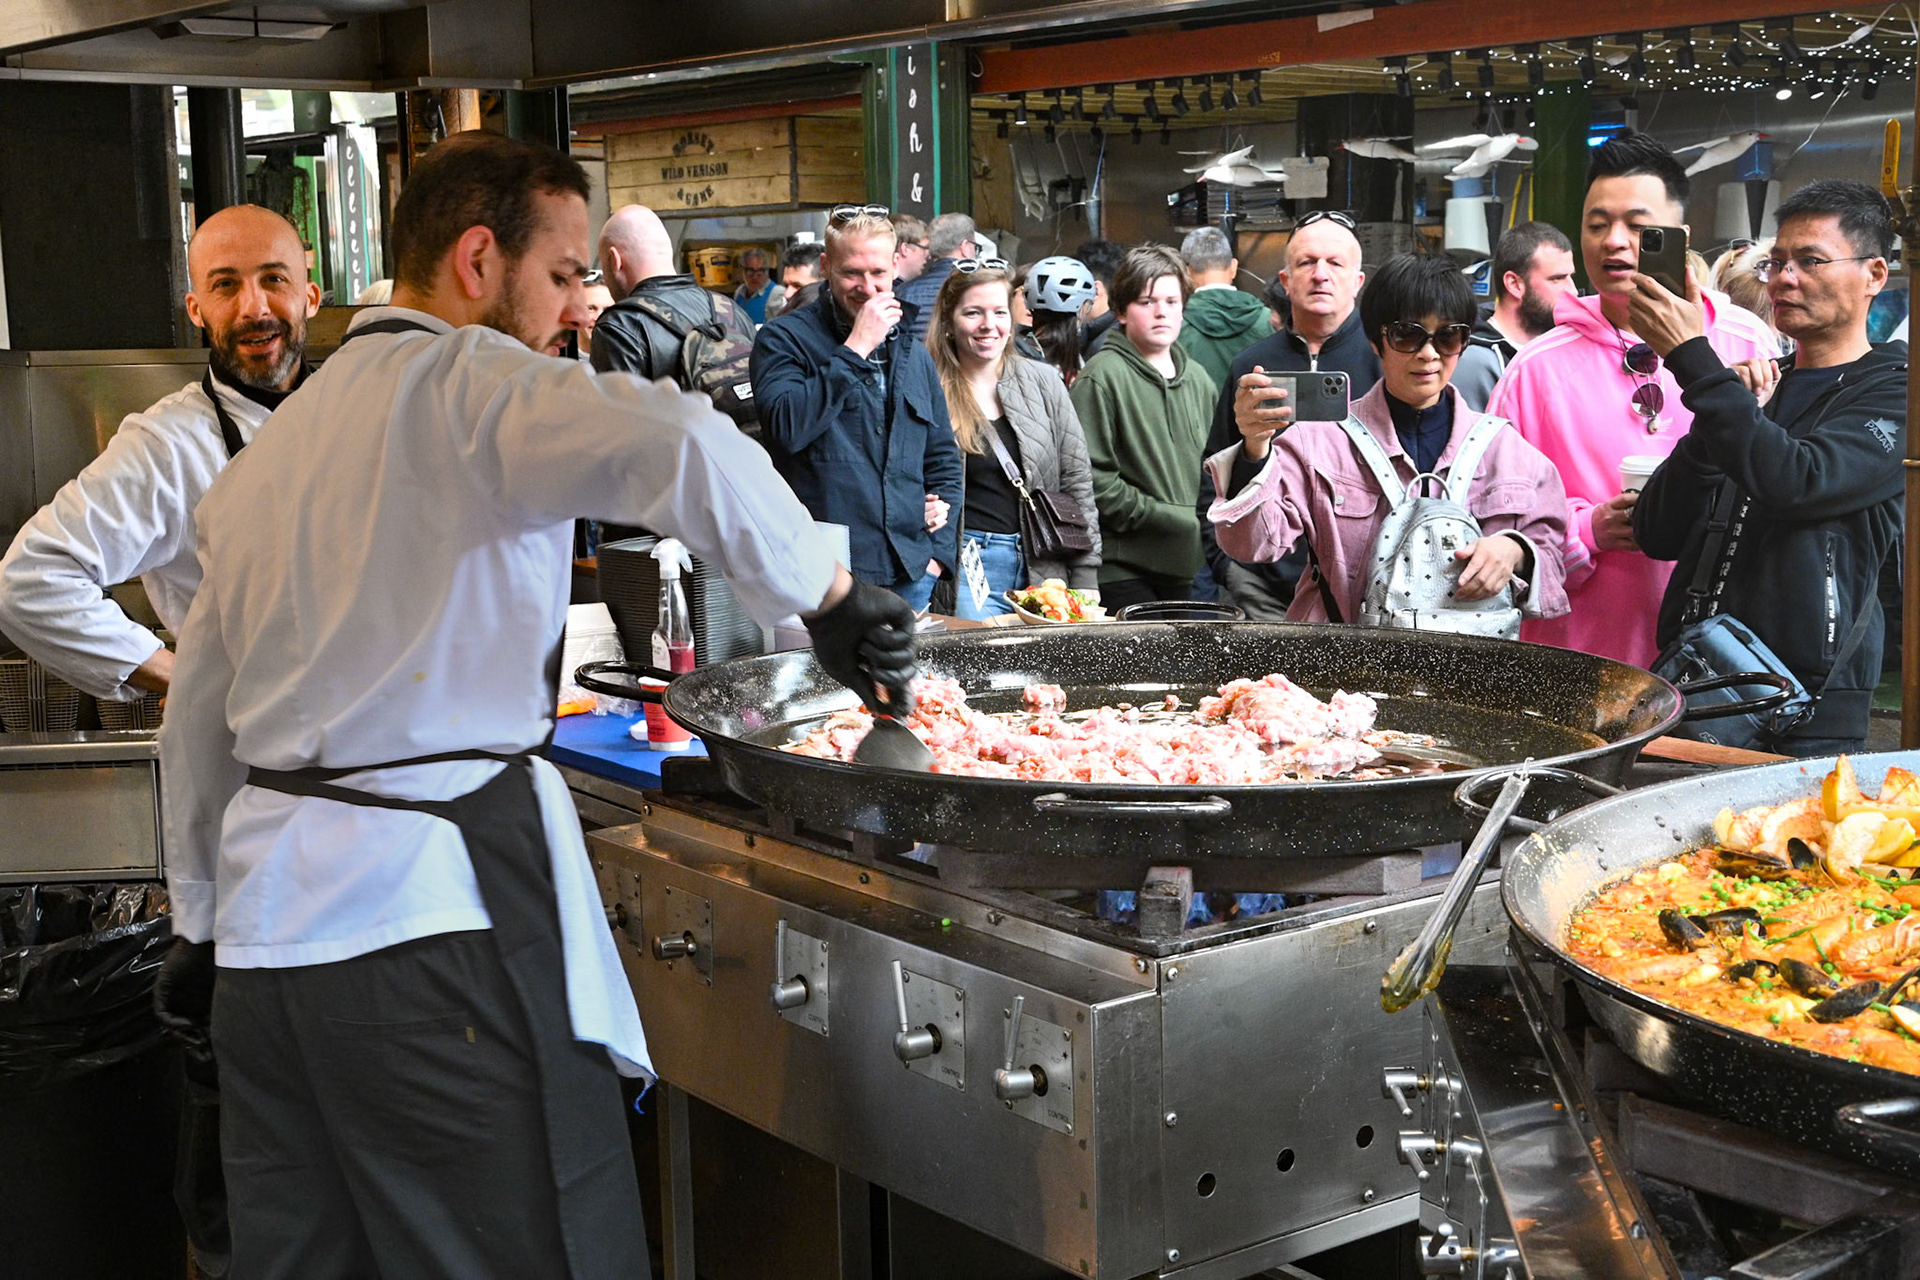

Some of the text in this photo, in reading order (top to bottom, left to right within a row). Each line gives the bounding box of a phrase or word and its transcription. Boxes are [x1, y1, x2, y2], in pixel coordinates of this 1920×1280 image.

[661, 162, 729, 180] WILD VENISON
[685, 184, 715, 207] GAME
[910, 172, 924, 203] &
[1864, 418, 1893, 453] PAJAR
